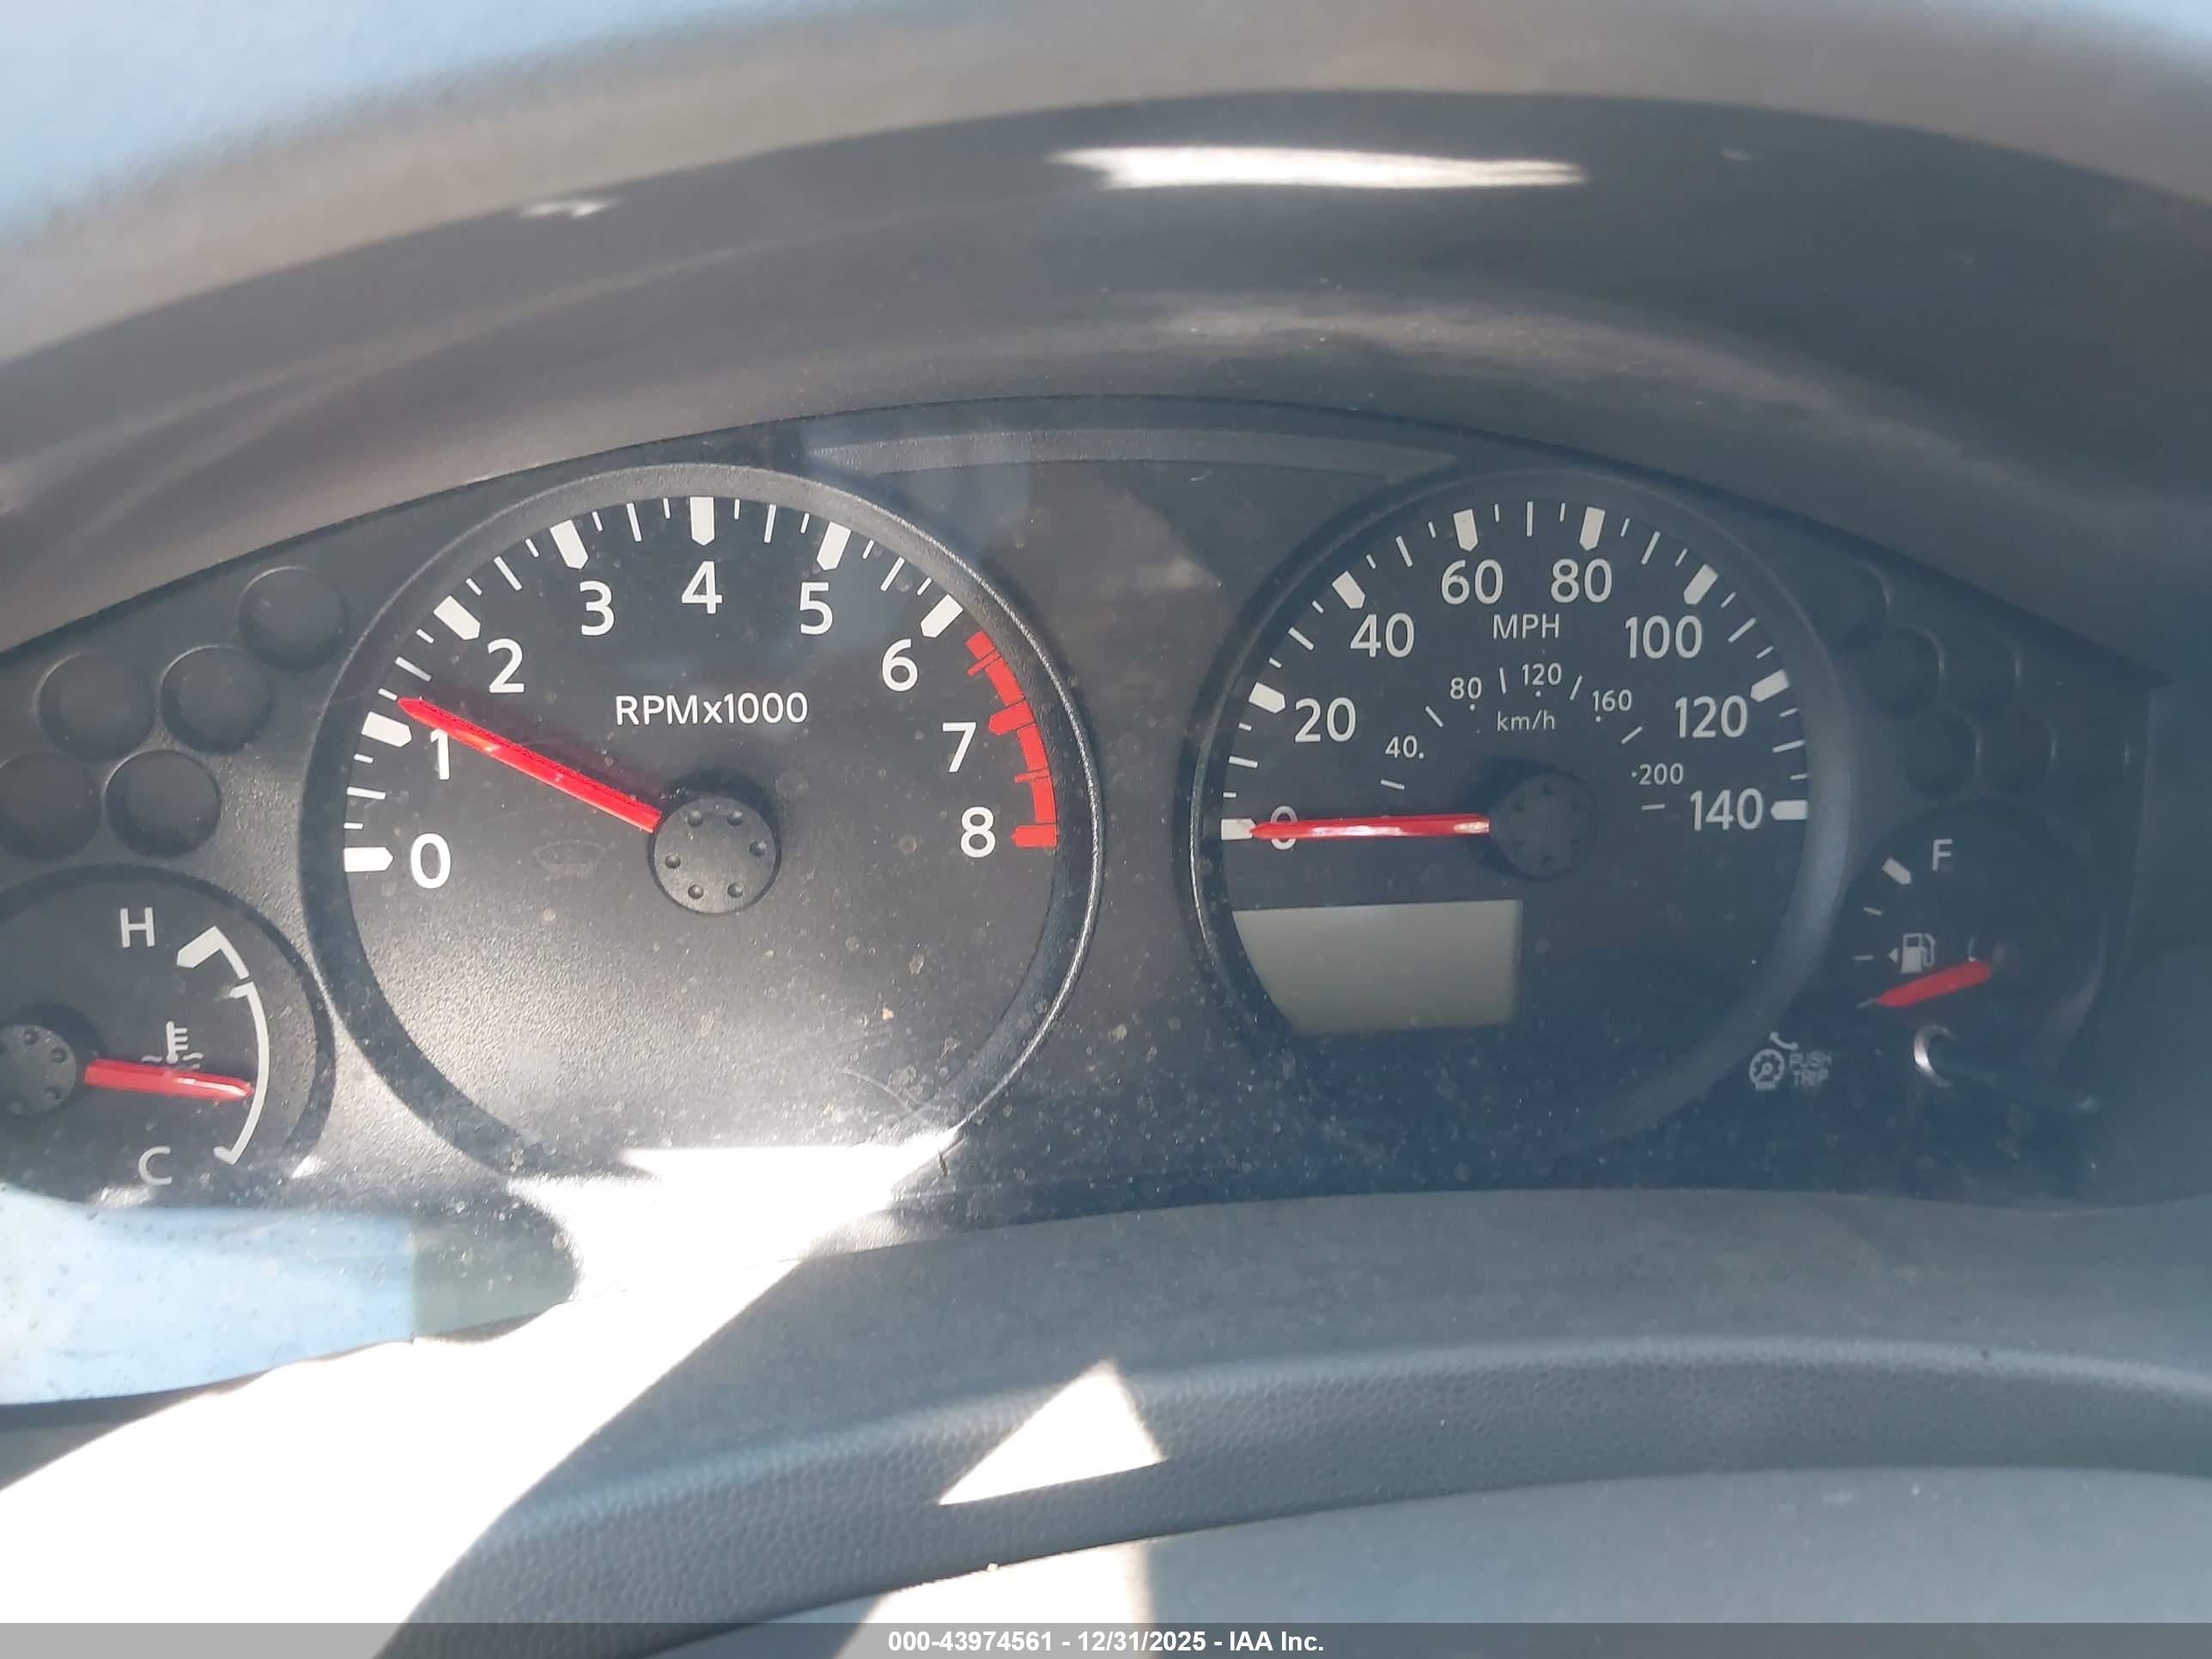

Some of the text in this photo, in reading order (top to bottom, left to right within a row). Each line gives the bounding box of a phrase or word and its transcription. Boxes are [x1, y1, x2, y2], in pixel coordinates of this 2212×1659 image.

[680, 561, 723, 615] 4
[1440, 559, 1504, 605] 60
[1550, 558, 1613, 604] 80
[579, 580, 615, 636] 3
[799, 581, 833, 635] 5
[1492, 613, 1559, 639] MPH
[1350, 611, 1415, 659] 40
[1625, 615, 1703, 659] 100
[487, 638, 526, 693] 2
[882, 640, 918, 691] 6
[1522, 664, 1562, 686] 120
[615, 691, 808, 726] RPMx1000
[1450, 678, 1482, 699] 80
[1592, 690, 1632, 712] 160
[1295, 696, 1356, 742] 20
[1496, 709, 1556, 732] km/h
[1674, 696, 1748, 739] 120
[428, 725, 451, 781] 1
[942, 721, 975, 773] 7
[1385, 736, 1419, 758] 40
[1639, 763, 1684, 785] 200
[1269, 805, 1297, 850] 0
[1690, 788, 1763, 831] 140
[959, 806, 996, 858] 8
[410, 833, 452, 889] 0
[1931, 839, 1953, 872] F
[120, 907, 155, 948] H
[1789, 1051, 1832, 1070] PUSH
[1793, 1068, 1829, 1086] TRIP
[138, 1146, 172, 1186] C
